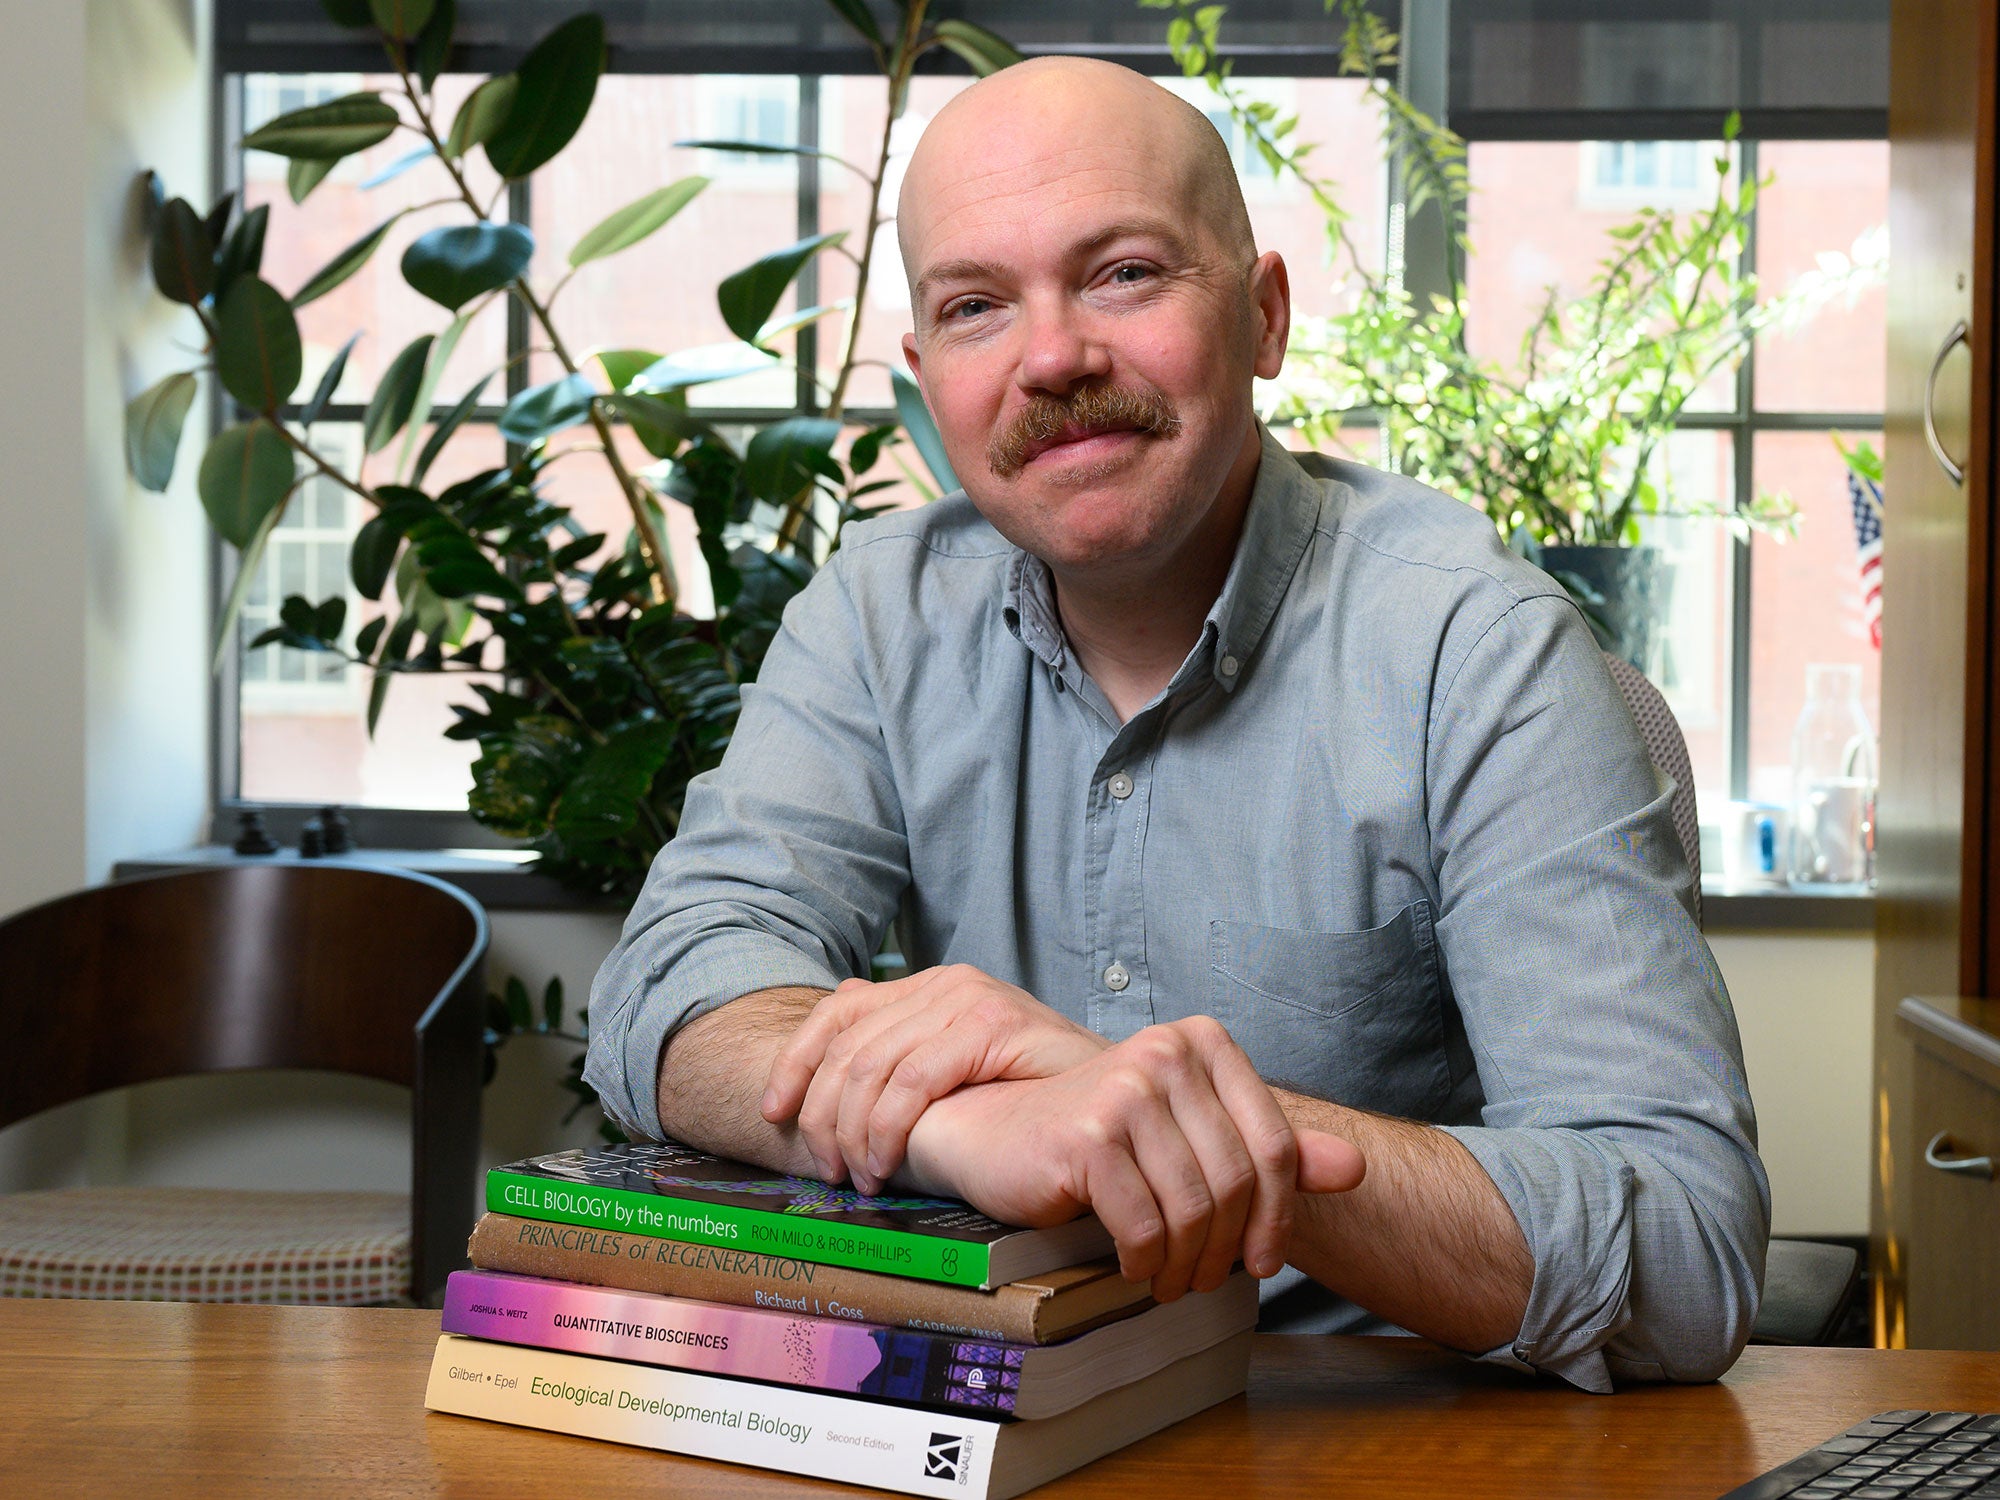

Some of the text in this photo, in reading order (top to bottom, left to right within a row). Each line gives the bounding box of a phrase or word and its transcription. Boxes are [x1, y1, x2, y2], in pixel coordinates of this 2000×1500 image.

[539, 1151, 649, 1171] CELL
[584, 1166, 640, 1178] by
[637, 1156, 701, 1169] the
[504, 1185, 738, 1239] CELL BIOLOGY by the numbers
[518, 1224, 816, 1284] PRINCIPLES of REGENERATION
[751, 1224, 912, 1264] RON MILO & ROB PHILLIPS
[469, 1303, 528, 1320] JOSHUA S. WEITZ
[754, 1290, 864, 1320] Richard J. Goss
[553, 1313, 729, 1351] QUANTITATIVE BIOSCIENCES
[907, 1318, 1004, 1341] ACADEMIC PRESS
[448, 1366, 518, 1389] Gilbert Epel
[530, 1376, 813, 1444] Ecological Developmental Biology
[826, 1430, 895, 1452] Second Edition
[958, 1434, 975, 1486] SINAUER
